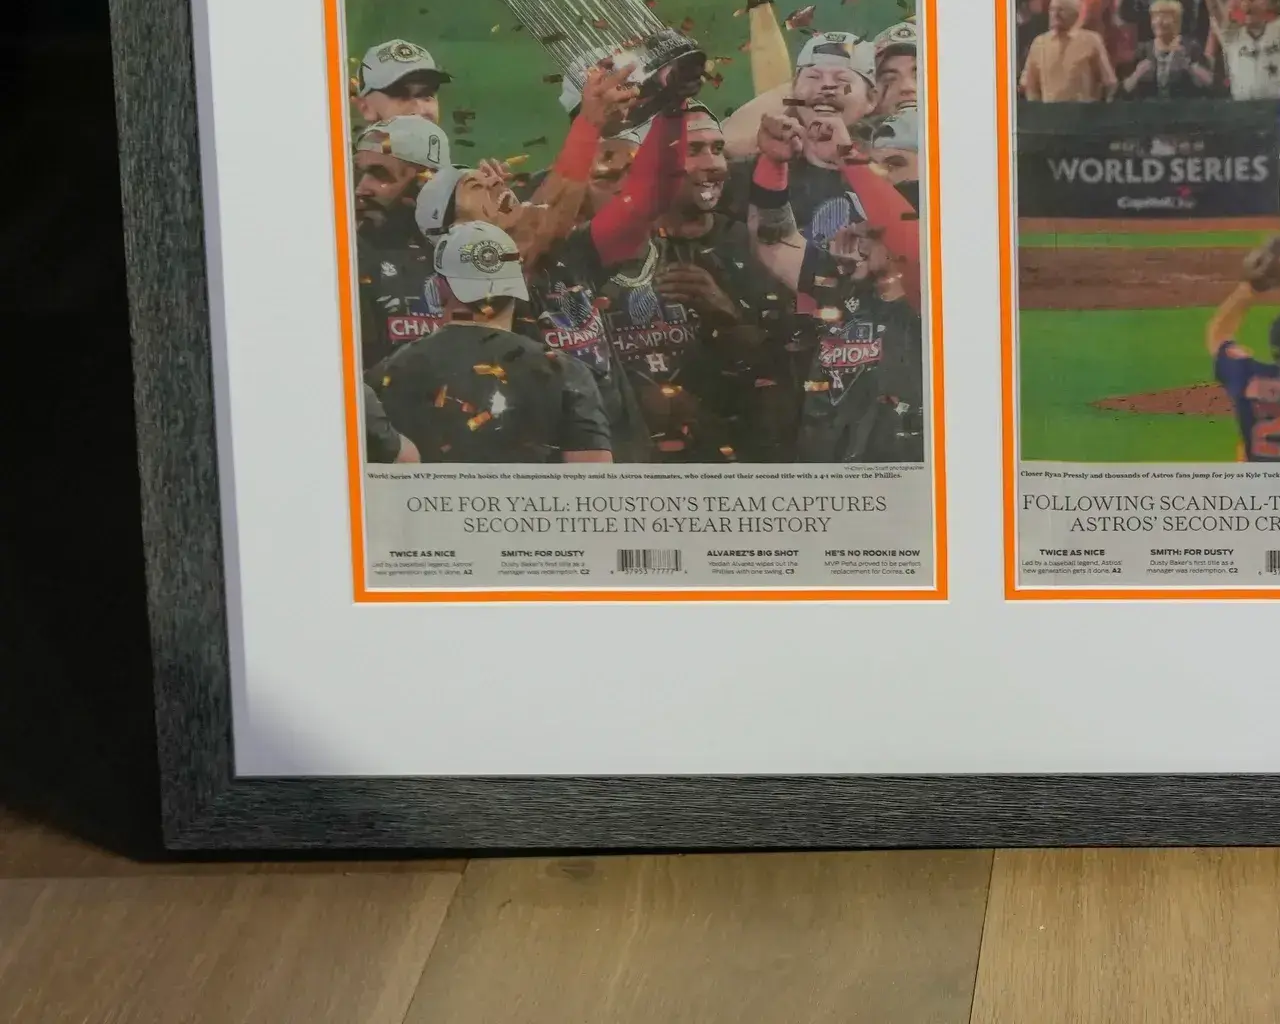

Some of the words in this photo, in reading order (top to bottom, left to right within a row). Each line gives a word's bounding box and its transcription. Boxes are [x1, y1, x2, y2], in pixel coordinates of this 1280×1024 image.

[1048, 158, 1164, 183] WORLD
[1168, 156, 1269, 182] SERIES
[406, 496, 453, 512] ONE
[458, 496, 502, 512] FOR
[506, 496, 570, 512] Y'ALL:
[576, 496, 699, 512] HOUSTON'S
[702, 496, 766, 512] TEAM
[772, 496, 887, 512] CAPTURES
[1023, 494, 1155, 512] FOLLOWING
[464, 517, 551, 533] SECOND
[556, 517, 618, 533] TITLE
[624, 517, 646, 532] IN
[652, 517, 732, 533] 61-YEAR
[738, 517, 831, 532] HISTORY
[1070, 516, 1158, 532] ASTROS'
[1162, 516, 1250, 532] SECOND
[388, 550, 418, 558] TWICE
[420, 550, 433, 558] AS
[434, 550, 456, 558] NICE
[500, 550, 533, 558] SMITH:
[706, 549, 756, 557] ALVAREZ'S
[756, 549, 773, 557] BIG
[774, 549, 800, 557] SHOT
[824, 549, 846, 557] HE'S
[847, 549, 862, 557] NO
[862, 549, 897, 557] ROOKIE
[898, 549, 921, 557] NOW
[1039, 548, 1069, 557] TWICE
[1069, 549, 1083, 557] AS
[1150, 548, 1182, 556] SMITH:
[1183, 548, 1202, 556] FOR
[1203, 548, 1234, 556] DUSTY
